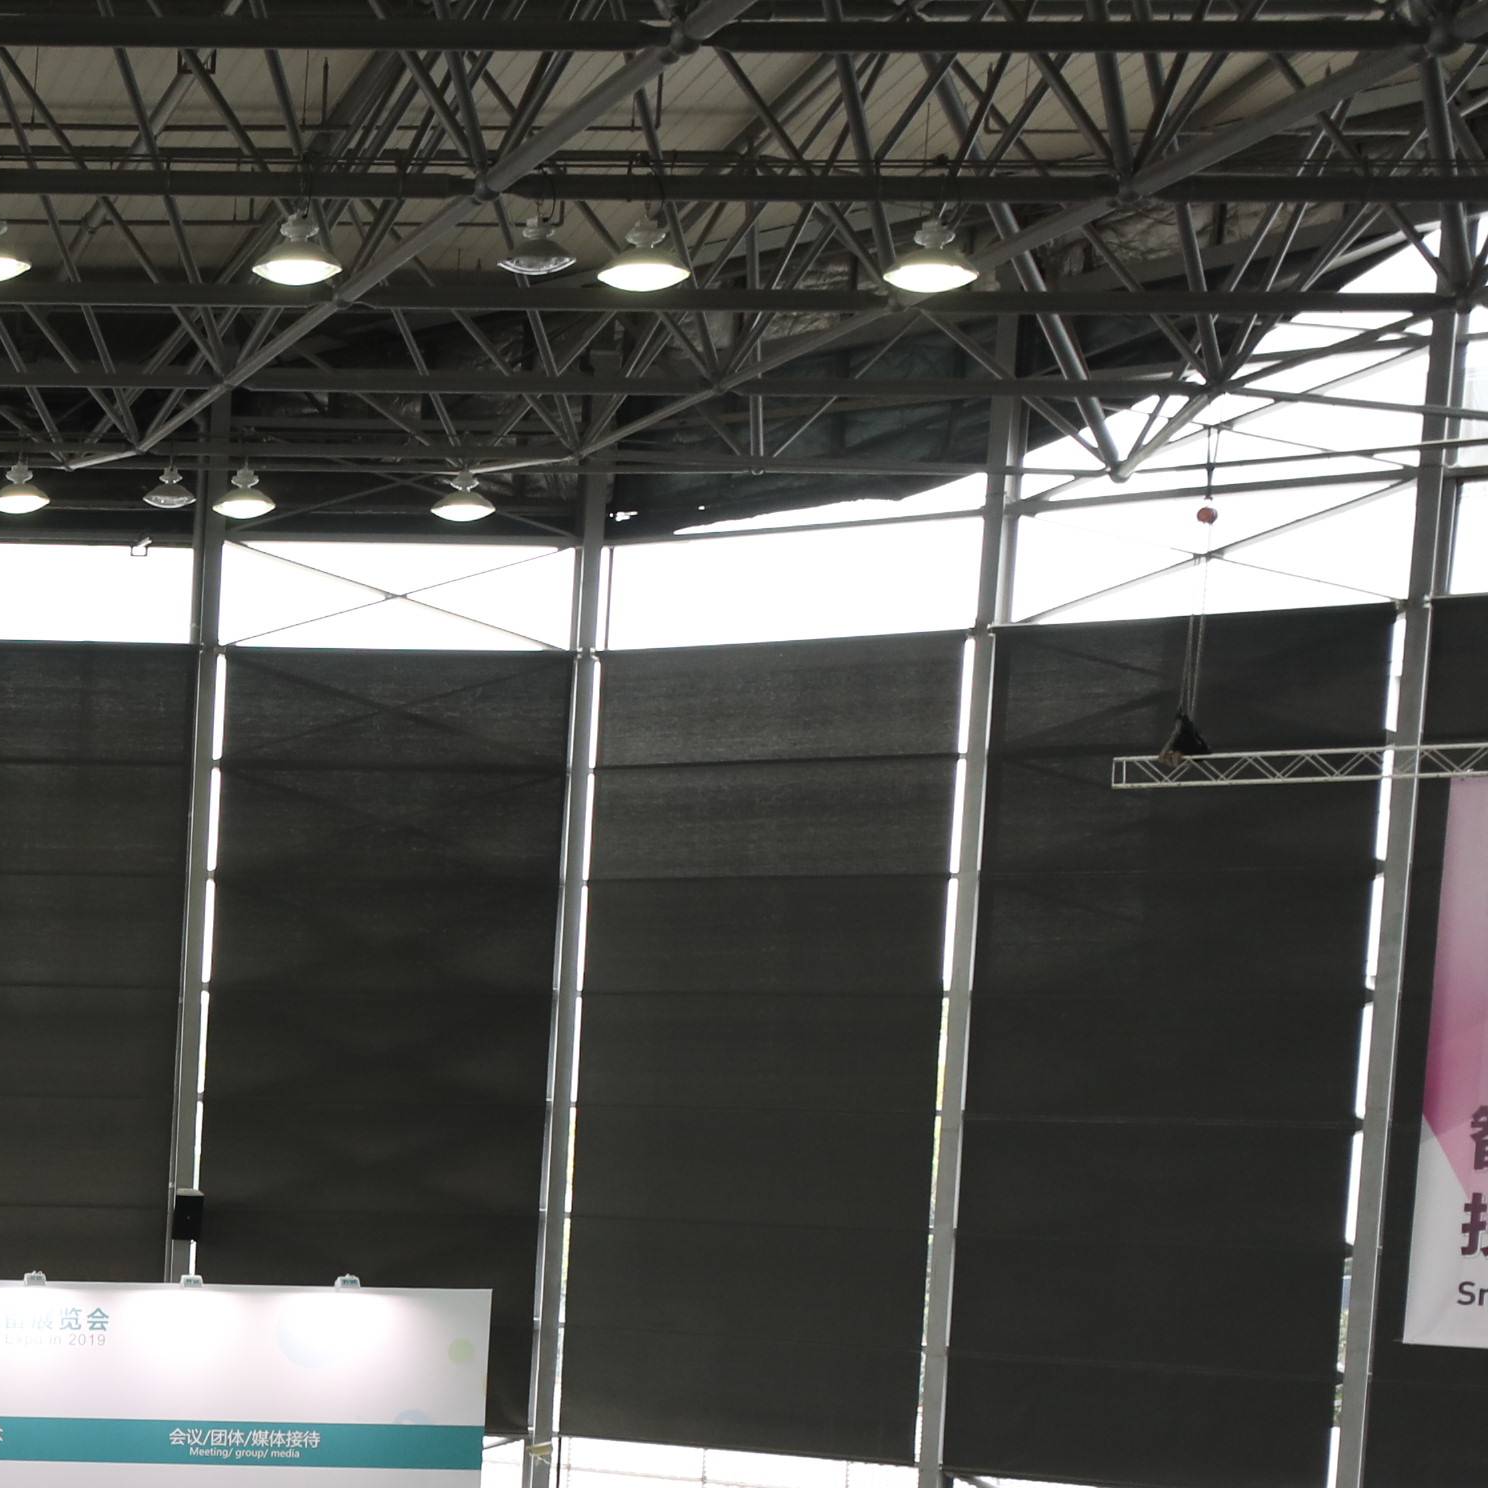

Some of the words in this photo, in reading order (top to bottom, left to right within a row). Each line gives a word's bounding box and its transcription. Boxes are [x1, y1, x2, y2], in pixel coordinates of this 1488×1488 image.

[68, 1334, 107, 1346] 2019
[168, 1428, 321, 1449] 会议/团体/媒体接待
[189, 1446, 233, 1459] Meeting/
[235, 1448, 269, 1460] group/
[271, 1448, 301, 1459] media
